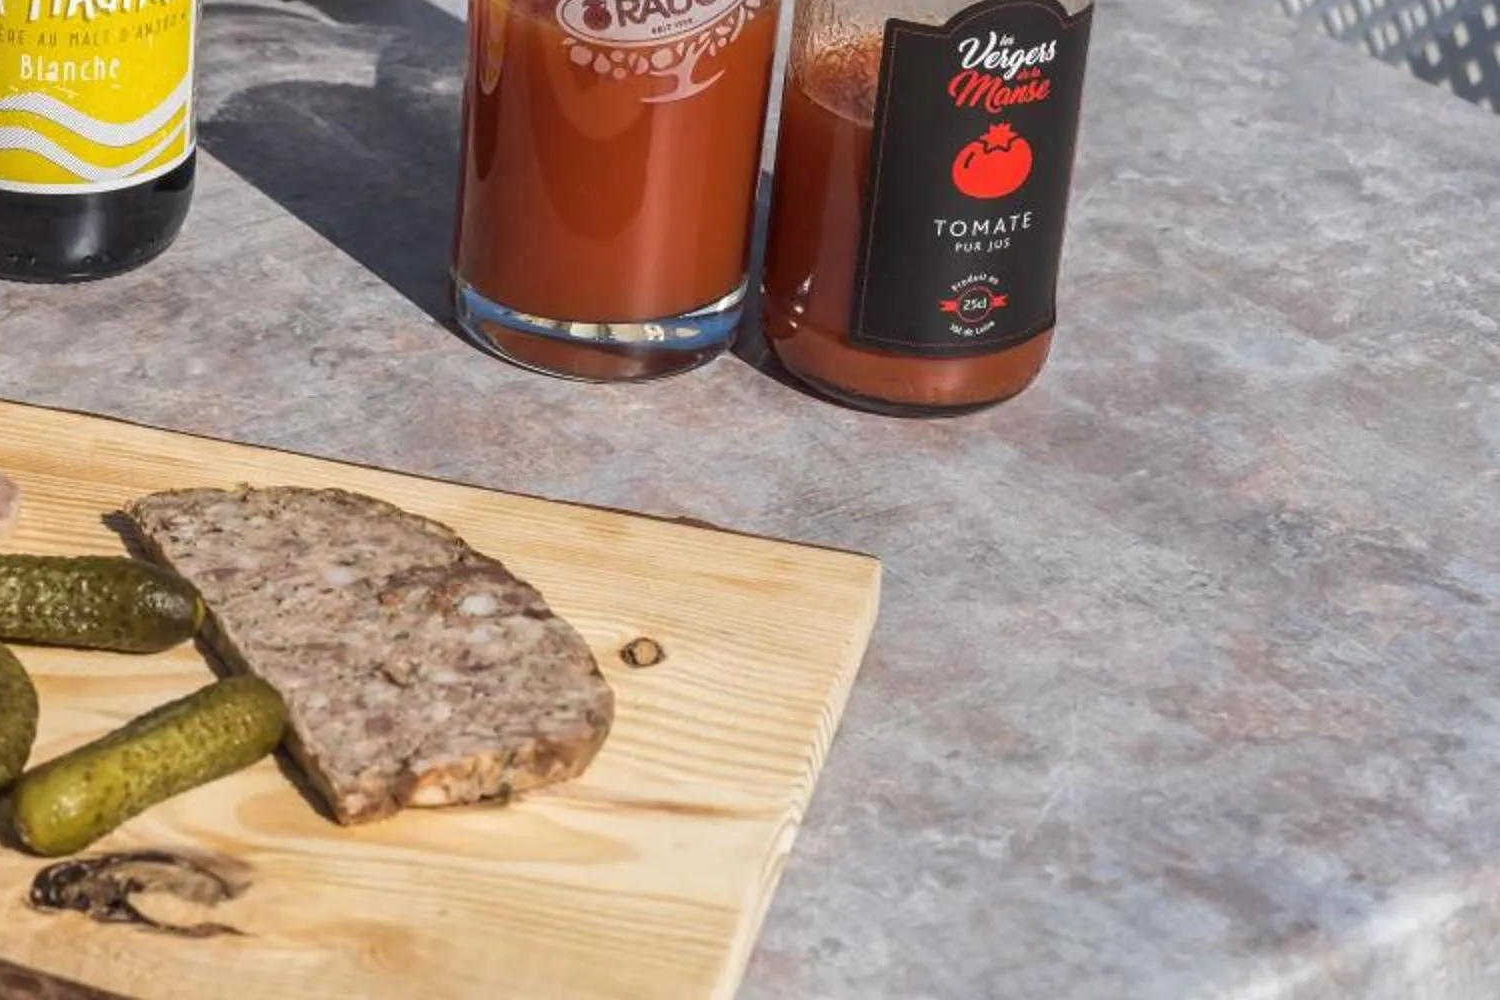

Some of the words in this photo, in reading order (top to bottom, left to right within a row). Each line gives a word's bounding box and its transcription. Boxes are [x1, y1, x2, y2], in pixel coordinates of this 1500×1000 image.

[37, 31, 58, 48] AU
[19, 53, 121, 82] Blanche
[958, 31, 1058, 81] Vergers
[947, 69, 1052, 114] Manse
[933, 211, 1033, 237] TOMATE
[955, 240, 981, 253] PUR
[986, 237, 1011, 253] JUS
